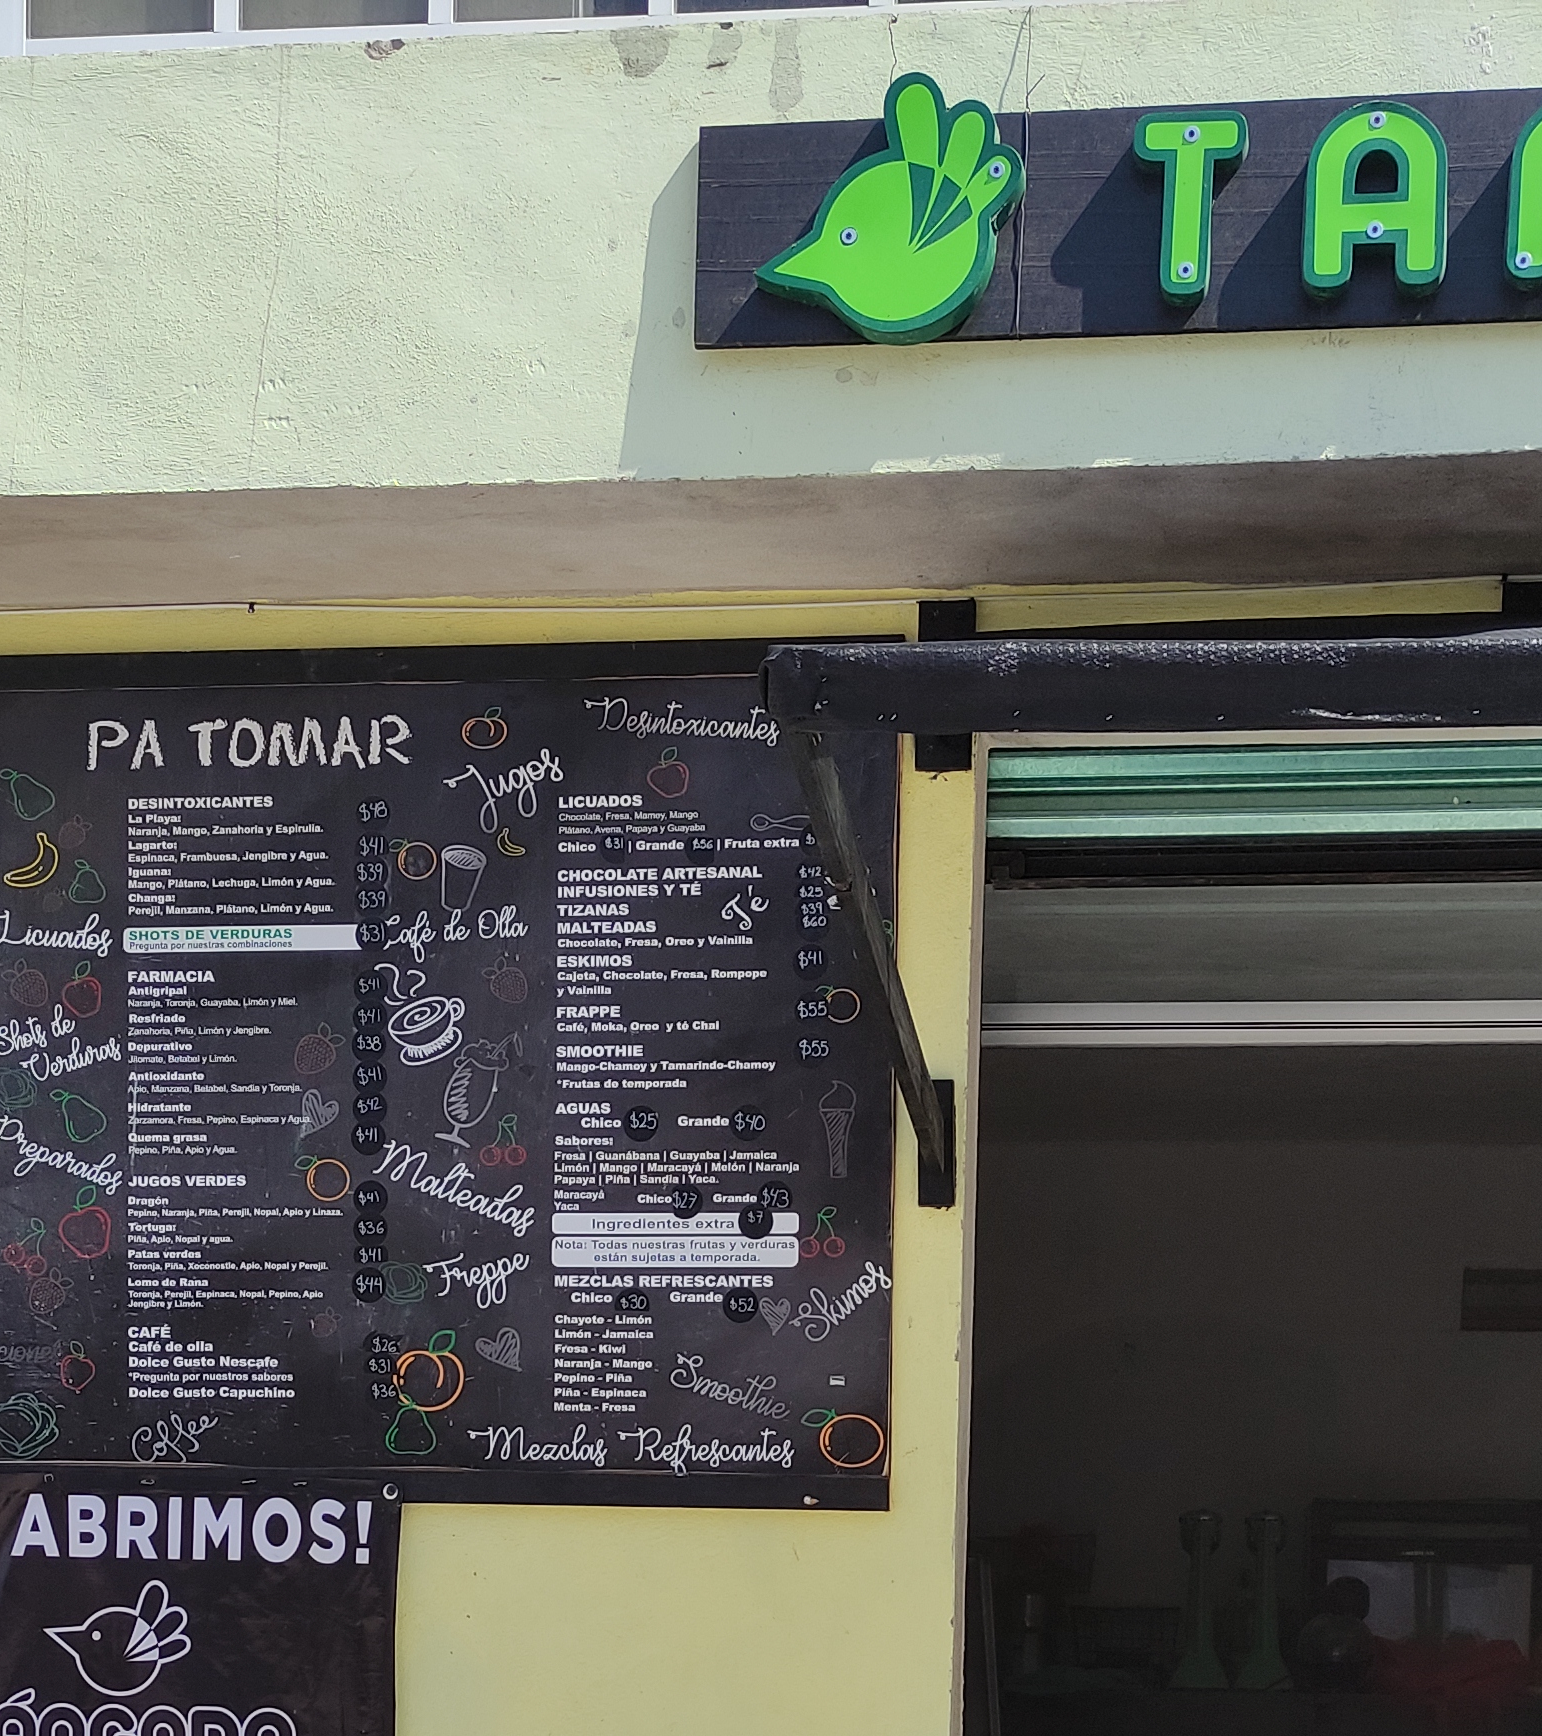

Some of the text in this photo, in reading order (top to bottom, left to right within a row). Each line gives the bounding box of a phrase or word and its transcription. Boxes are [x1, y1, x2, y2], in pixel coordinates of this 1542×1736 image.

[86, 714, 413, 771] PA TOMAR
[127, 795, 274, 810] DESINTOXICANTES
[558, 794, 643, 809] LICUADOS
[557, 865, 763, 882] CHOCOLATE ARTESANAL
[557, 880, 702, 899] INFUSIONES Y TÉ
[556, 903, 630, 917] TIZANAS
[557, 920, 657, 935] MALTEADAS
[128, 928, 293, 942] SHOTS DE VERDURAS
[556, 954, 633, 968] ESKIMOS
[127, 970, 216, 983] FARMACIA
[556, 1005, 621, 1019] FRAPPE
[555, 1044, 644, 1058] SMOOTHIE
[555, 1102, 611, 1115] AGUAS
[581, 1117, 621, 1128] Chico
[677, 1116, 729, 1127] Grande
[127, 1174, 247, 1188] JUGOS VERDES
[591, 1218, 734, 1231] Ingredientes extra
[554, 1239, 795, 1252] Nota: Todas nuestras frutas y verduras
[593, 1249, 761, 1265] están sujetas a temporada.
[554, 1274, 774, 1288] MEZCLAS REFRESCANTES
[127, 1323, 172, 1339] CAFÉ
[128, 1340, 214, 1353] Café de olla
[128, 1386, 296, 1401] Dolce Gusto Capuchino
[11, 1494, 372, 1564] ABRIMOS!
